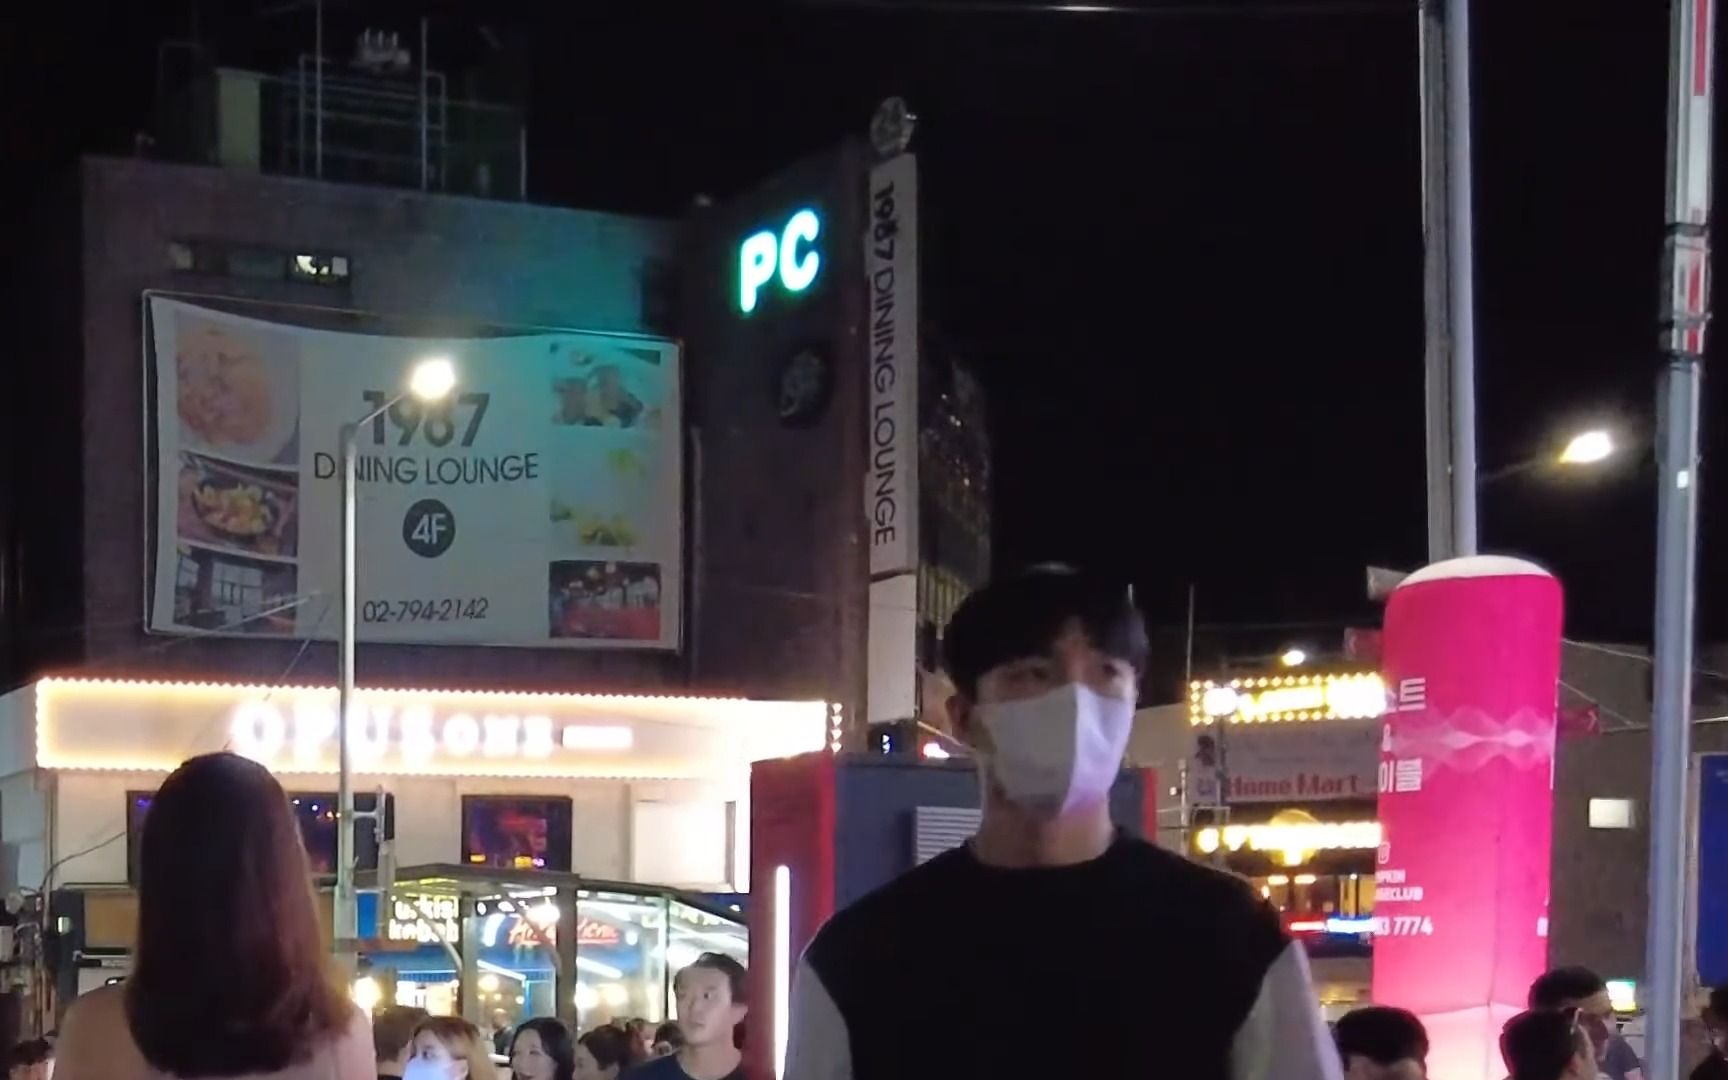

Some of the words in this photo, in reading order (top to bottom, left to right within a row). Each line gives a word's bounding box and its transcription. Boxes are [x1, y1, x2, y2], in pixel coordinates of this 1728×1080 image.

[739, 207, 821, 313] PC
[873, 182, 897, 260] 1987
[874, 266, 895, 393] DINING
[313, 452, 419, 485] DNING
[425, 453, 539, 486] LOUNGE
[874, 401, 896, 546] LOUNGE
[411, 513, 446, 545] 4F
[363, 596, 489, 624] 02-794-2142
